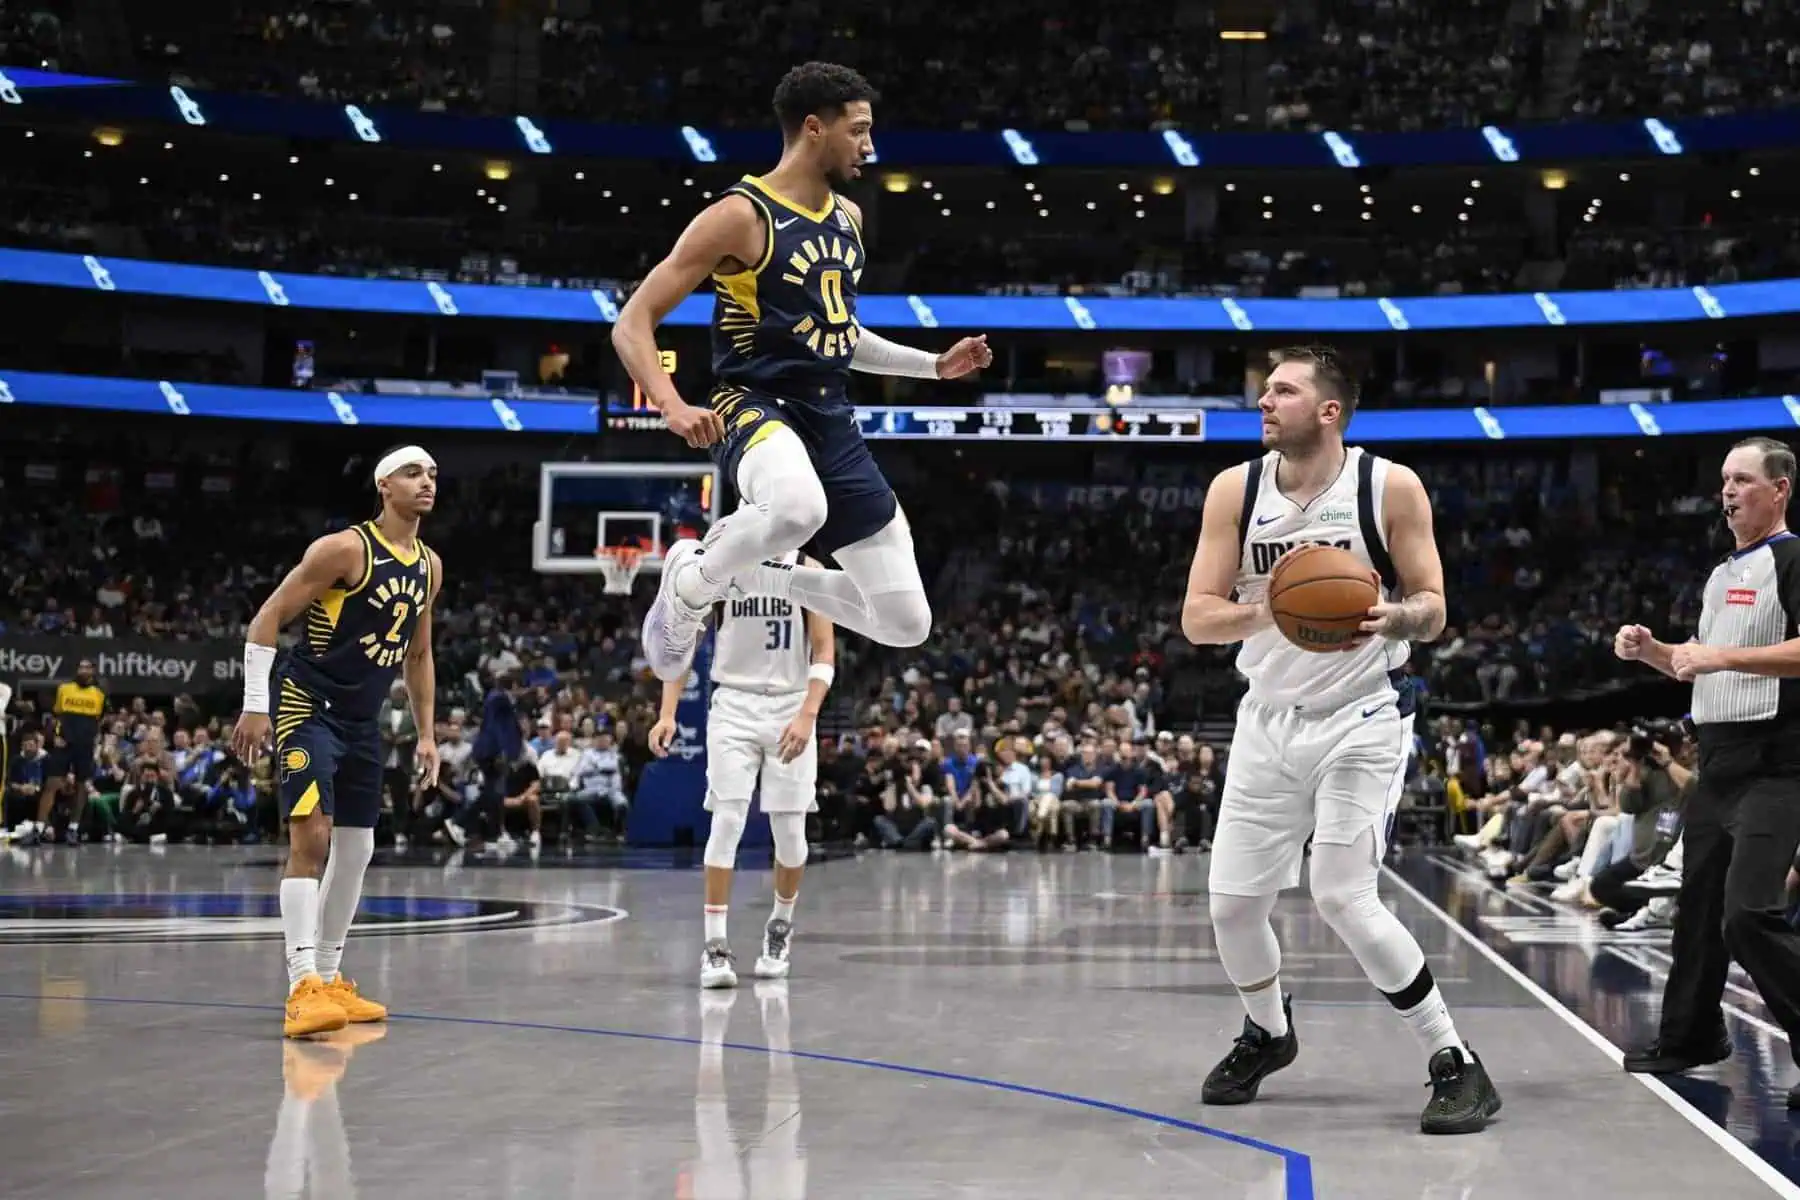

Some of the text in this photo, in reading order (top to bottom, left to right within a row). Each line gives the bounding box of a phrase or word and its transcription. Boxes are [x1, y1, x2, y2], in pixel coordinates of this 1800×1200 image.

[821, 270, 849, 324] 0
[792, 315, 860, 357] PACER
[1320, 508, 1353, 522] chime
[385, 601, 409, 643] 2
[731, 596, 793, 618] DALLAS
[360, 632, 409, 668] PACER
[765, 620, 792, 651] 31
[99, 651, 197, 682] hiftkey
